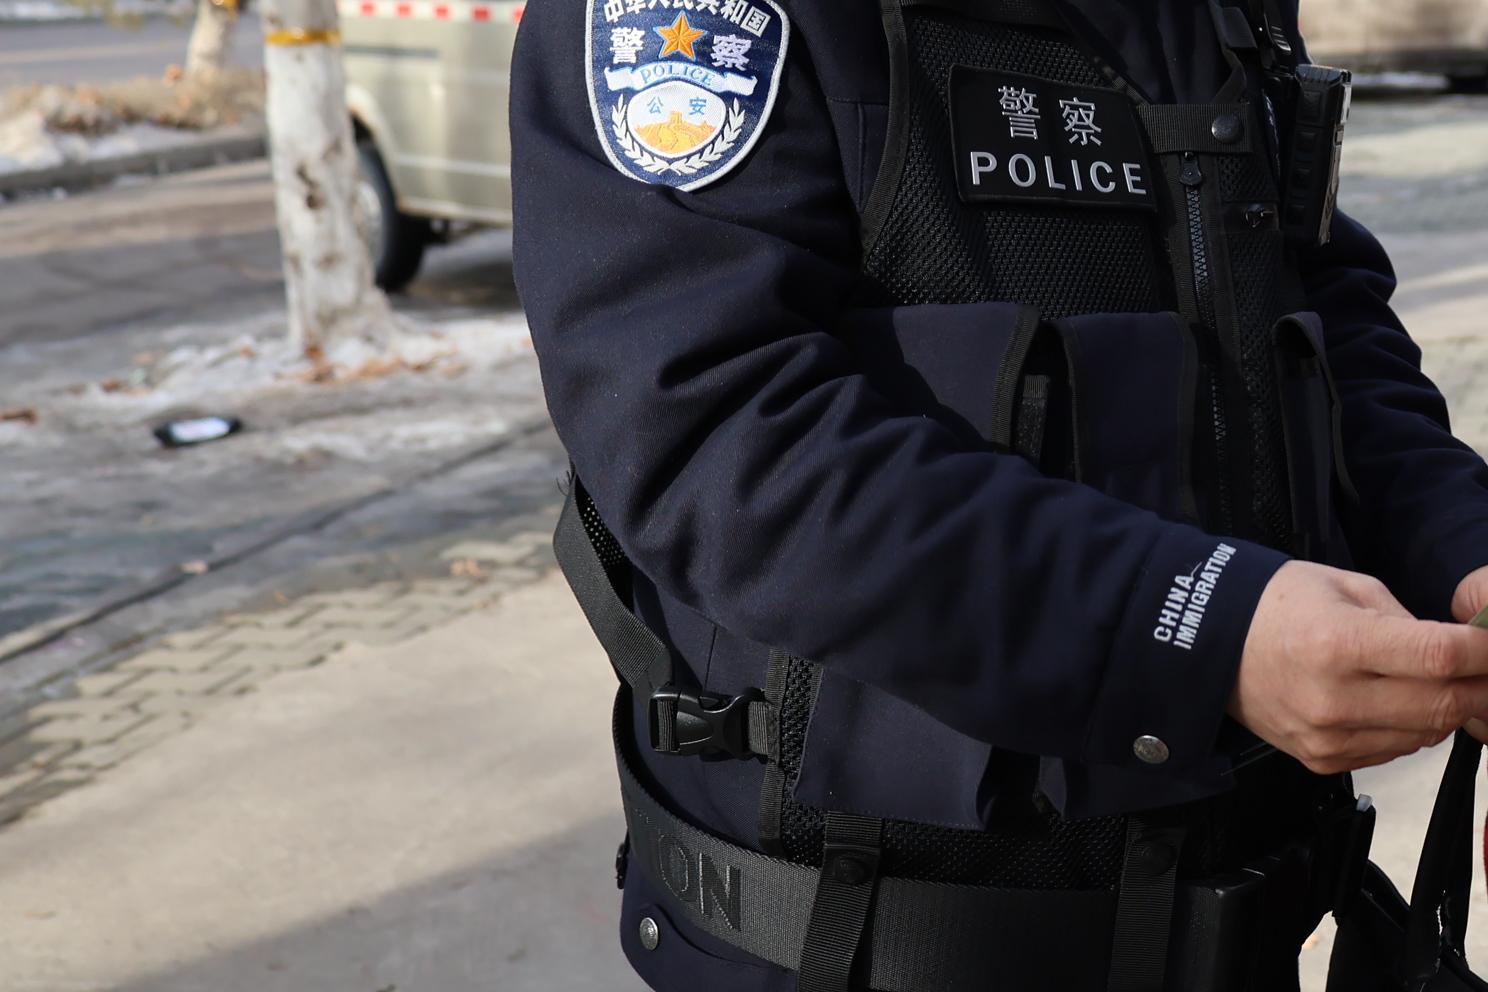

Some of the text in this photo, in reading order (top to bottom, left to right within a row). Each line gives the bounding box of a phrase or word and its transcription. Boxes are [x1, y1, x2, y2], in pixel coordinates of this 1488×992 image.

[639, 62, 717, 87] POLICE
[646, 96, 707, 116] 公安
[998, 85, 1102, 146] 警察
[970, 151, 1147, 195] POLICE
[1153, 574, 1194, 642] CHINA
[1173, 542, 1236, 649] IMMIGRATION
[654, 830, 741, 932] ON
